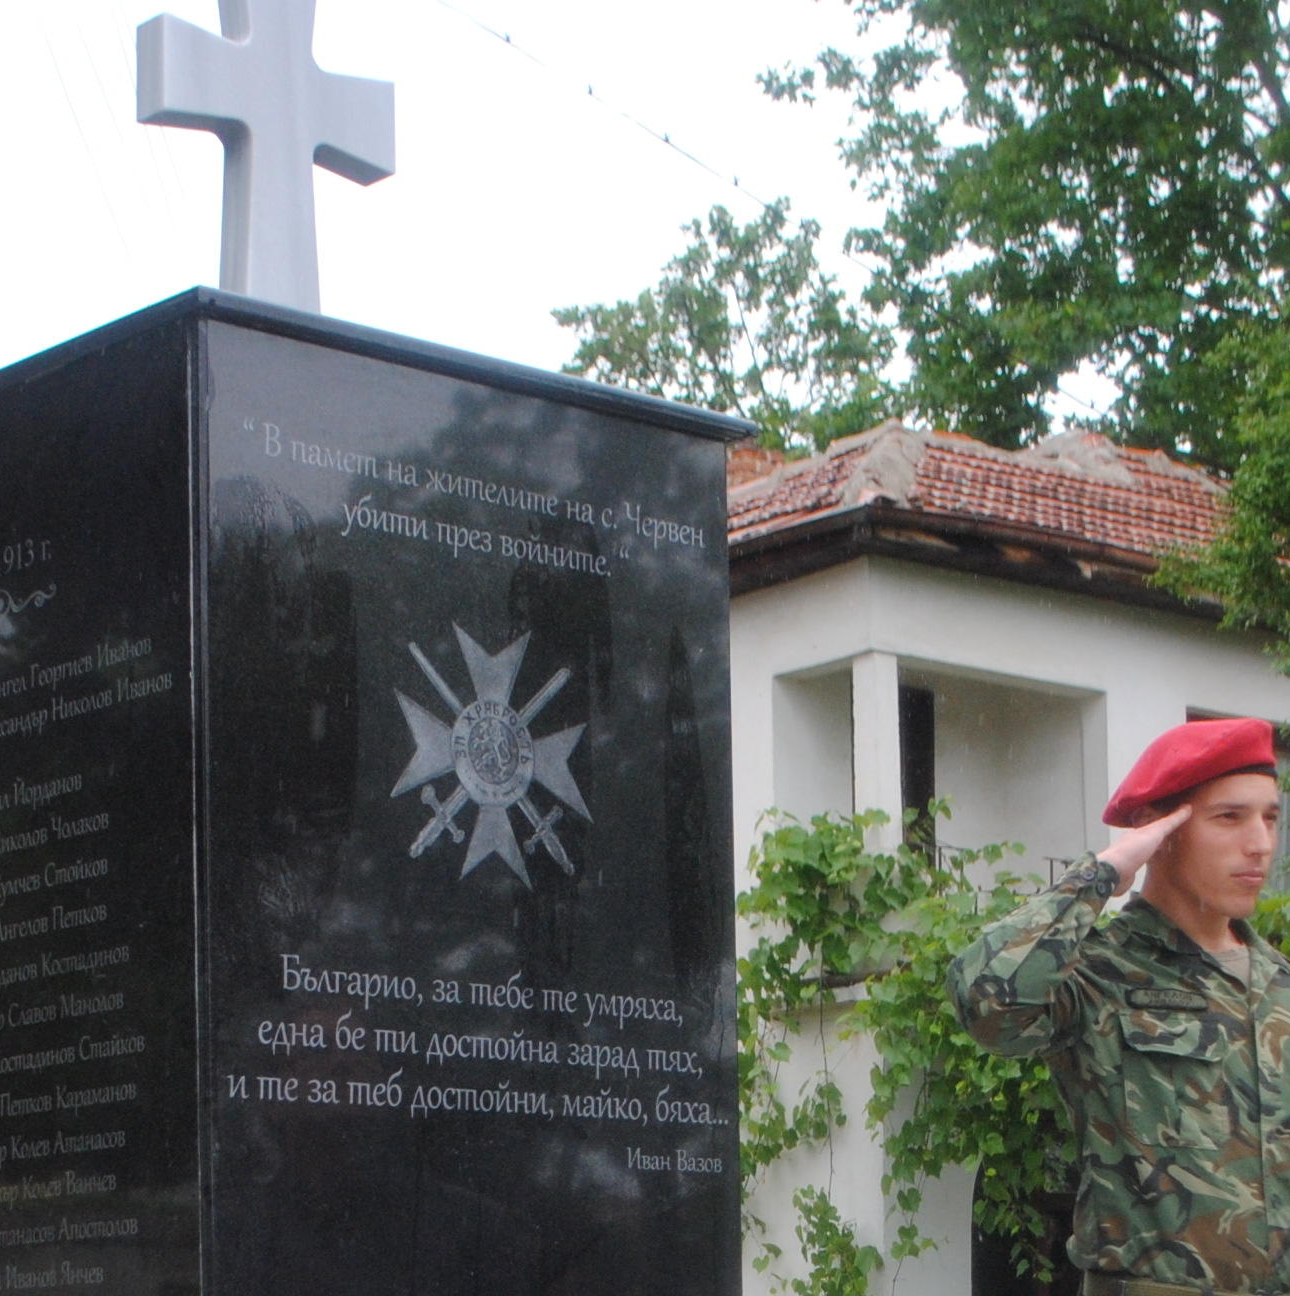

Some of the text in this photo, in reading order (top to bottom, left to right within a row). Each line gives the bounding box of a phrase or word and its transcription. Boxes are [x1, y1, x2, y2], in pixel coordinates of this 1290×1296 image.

[263, 422, 282, 457] В
[291, 443, 379, 479] памет
[388, 460, 418, 487] на
[425, 468, 558, 517] жителите
[565, 498, 594, 525] на
[601, 506, 618, 530] с.
[625, 501, 706, 548] Червен
[41, 538, 53, 561] г.
[341, 492, 429, 539] убити
[436, 521, 493, 559] през
[501, 529, 612, 577] войните.
[29, 654, 93, 692] Георгиев
[96, 637, 151, 672] Иванов
[51, 688, 112, 724] Николов
[116, 671, 172, 706] Иванов
[13, 772, 82, 811] Йорданов
[51, 811, 109, 843] Чолаков
[44, 856, 108, 889] Стойков
[52, 903, 107, 933] Петков
[40, 944, 129, 979] Костадинов
[279, 953, 684, 1030] Българио, за тебе те умряха,
[8, 1002, 56, 1028] Славов
[78, 1031, 145, 1062] Стайков
[258, 1011, 705, 1083] една бе ти достойна зарад тях,
[55, 1082, 137, 1117] Караманов
[227, 1068, 730, 1128] и те за теб достойни, майко, бяха...
[10, 1135, 50, 1161] Колев
[52, 1129, 126, 1156] Атанасов
[626, 1145, 724, 1175] Иван Вазов
[21, 1175, 62, 1201] Колев
[65, 1170, 116, 1197] Ванчев
[57, 1216, 138, 1242] Апостолов
[5, 1265, 56, 1290] Иванов
[60, 1261, 104, 1287] Янчев
